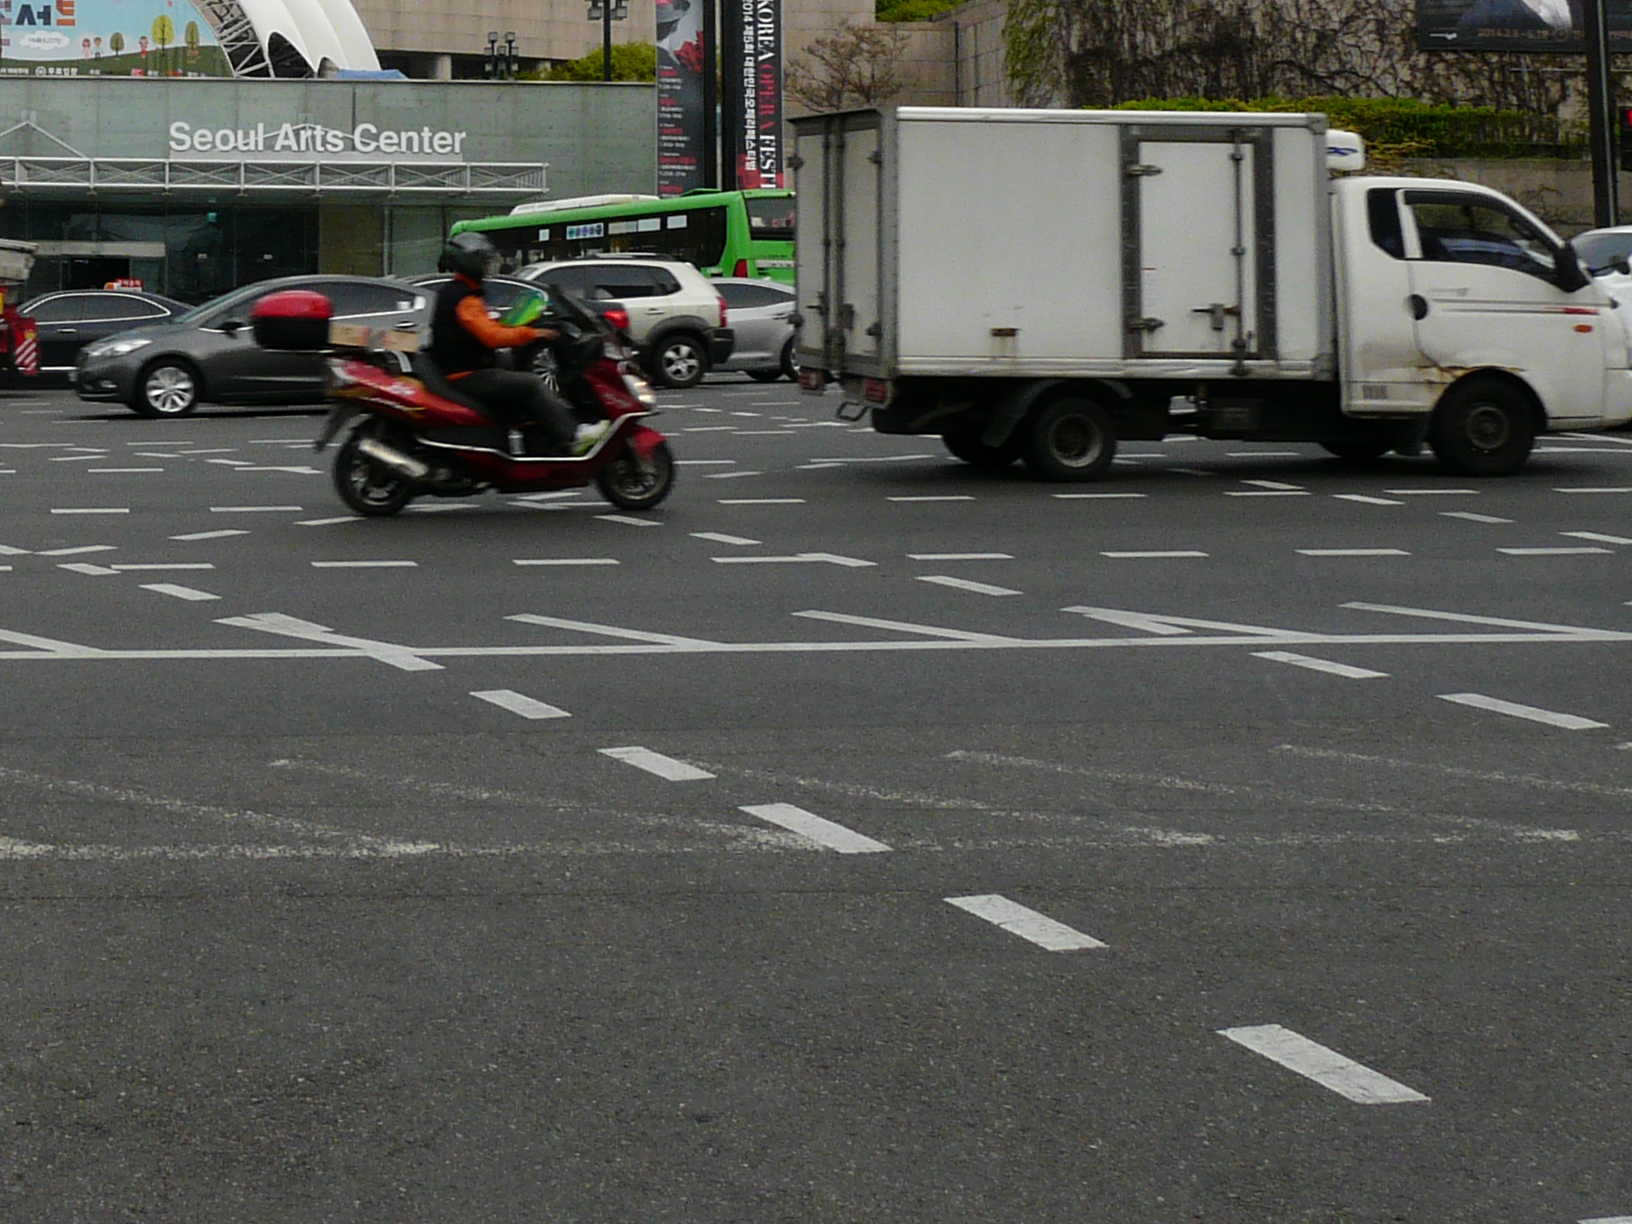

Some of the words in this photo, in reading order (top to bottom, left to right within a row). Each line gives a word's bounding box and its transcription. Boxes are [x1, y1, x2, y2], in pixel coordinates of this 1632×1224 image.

[758, 64, 776, 130] OPERA
[169, 121, 264, 151] Seoul
[274, 122, 343, 152] Arts
[354, 122, 466, 154] Center
